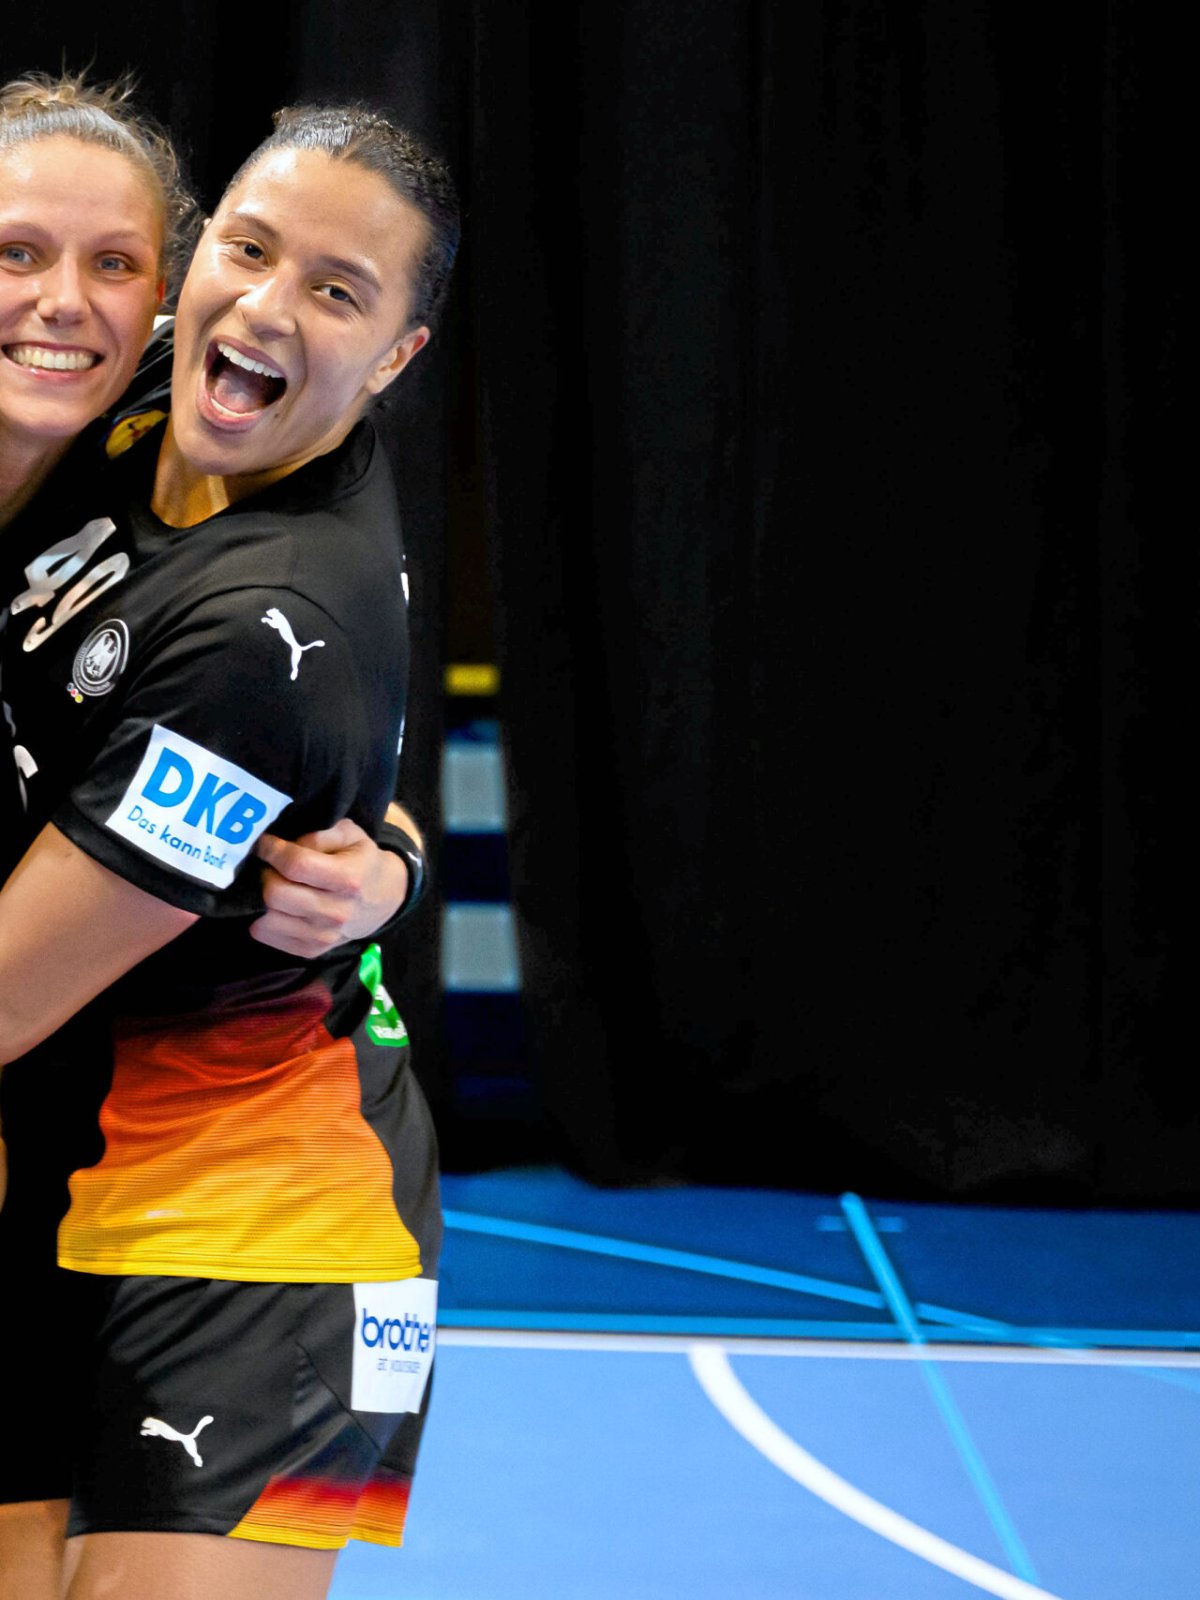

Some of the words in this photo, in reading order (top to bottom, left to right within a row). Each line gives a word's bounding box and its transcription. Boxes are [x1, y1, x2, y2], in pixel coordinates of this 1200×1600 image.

[10, 516, 130, 652] 49
[127, 804, 157, 834] Das
[159, 825, 201, 859] kann
[141, 746, 268, 845] DKB
